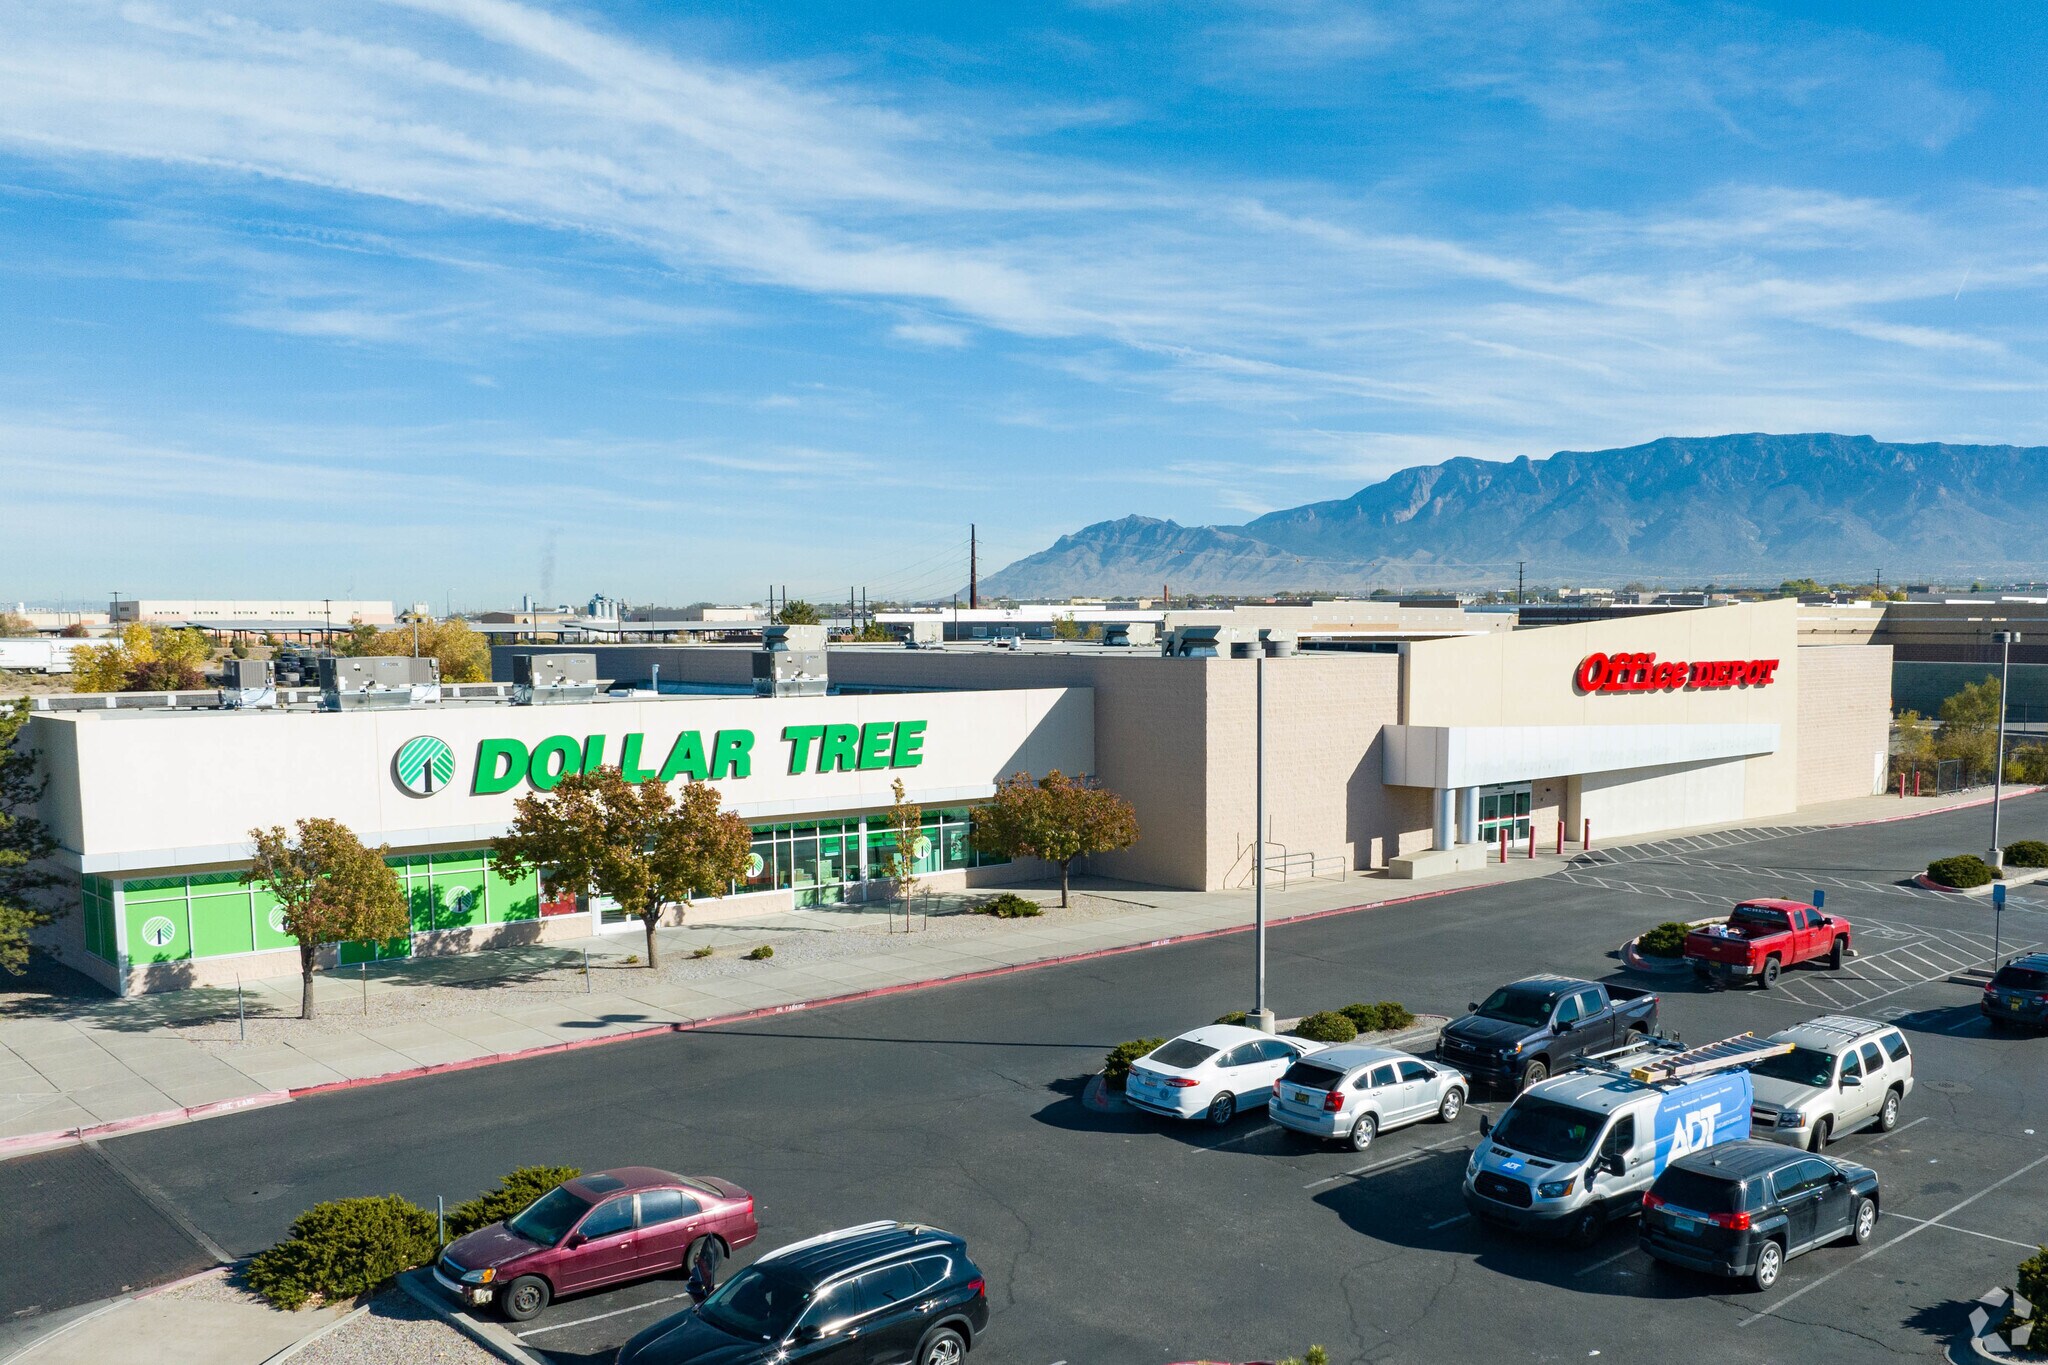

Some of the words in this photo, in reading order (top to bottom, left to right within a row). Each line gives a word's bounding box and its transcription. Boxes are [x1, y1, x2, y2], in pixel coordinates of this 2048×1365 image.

[1577, 652, 1689, 692] Office
[1689, 659, 1780, 688] DEPOT
[474, 730, 756, 794] DOLLAR
[783, 720, 928, 774] TREE
[237, 1097, 257, 1108] LANE
[1665, 1102, 1721, 1168] ADT
[1502, 1162, 1521, 1170] ADT
